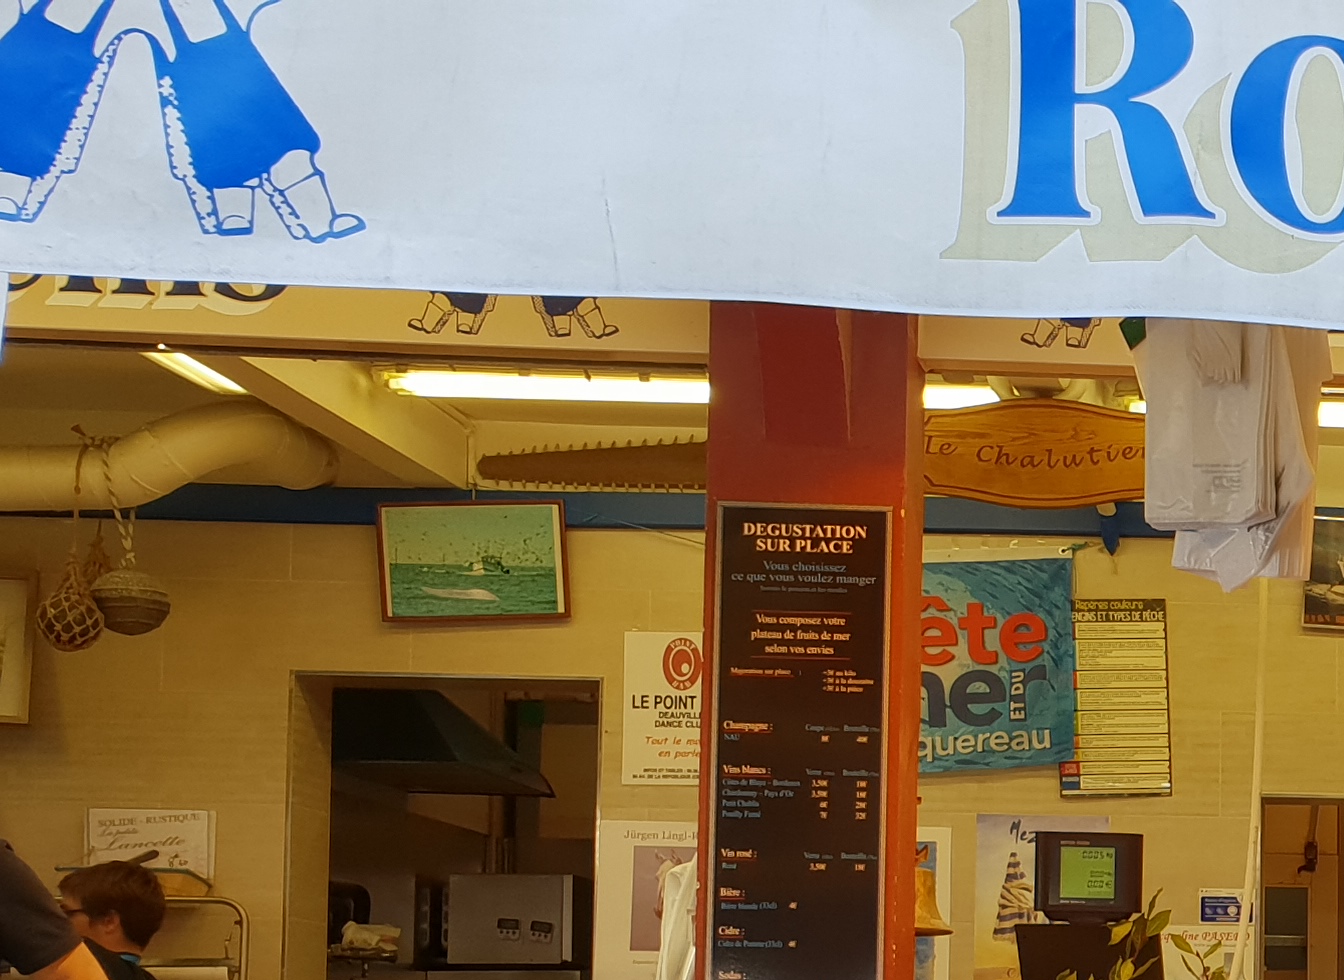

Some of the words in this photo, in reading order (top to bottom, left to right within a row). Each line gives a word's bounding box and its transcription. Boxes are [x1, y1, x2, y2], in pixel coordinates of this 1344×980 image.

[925, 435, 958, 456] Le
[976, 444, 1145, 469] Chalutie
[743, 523, 867, 540] DEGUSTATION
[756, 538, 790, 551] SUR
[795, 540, 852, 553] PLACE
[763, 561, 789, 570] Vous
[792, 562, 846, 574] choisissez
[747, 574, 766, 582] que
[798, 573, 833, 583] voulez
[836, 577, 876, 586] manger
[1072, 611, 1097, 622] ENGINS
[1098, 611, 1107, 621] ET
[1108, 611, 1131, 621] TYPES
[1132, 611, 1141, 621] DE
[921, 595, 1048, 667] ête
[1011, 671, 1025, 695] DU
[632, 694, 649, 709] LE
[654, 695, 697, 710] POINT
[1010, 701, 1026, 720] ET
[645, 736, 668, 745] Tout
[673, 736, 682, 745] le
[920, 729, 1052, 763] quereau
[97, 818, 137, 827] SOLIDE
[145, 813, 200, 825] RUSTIQUE
